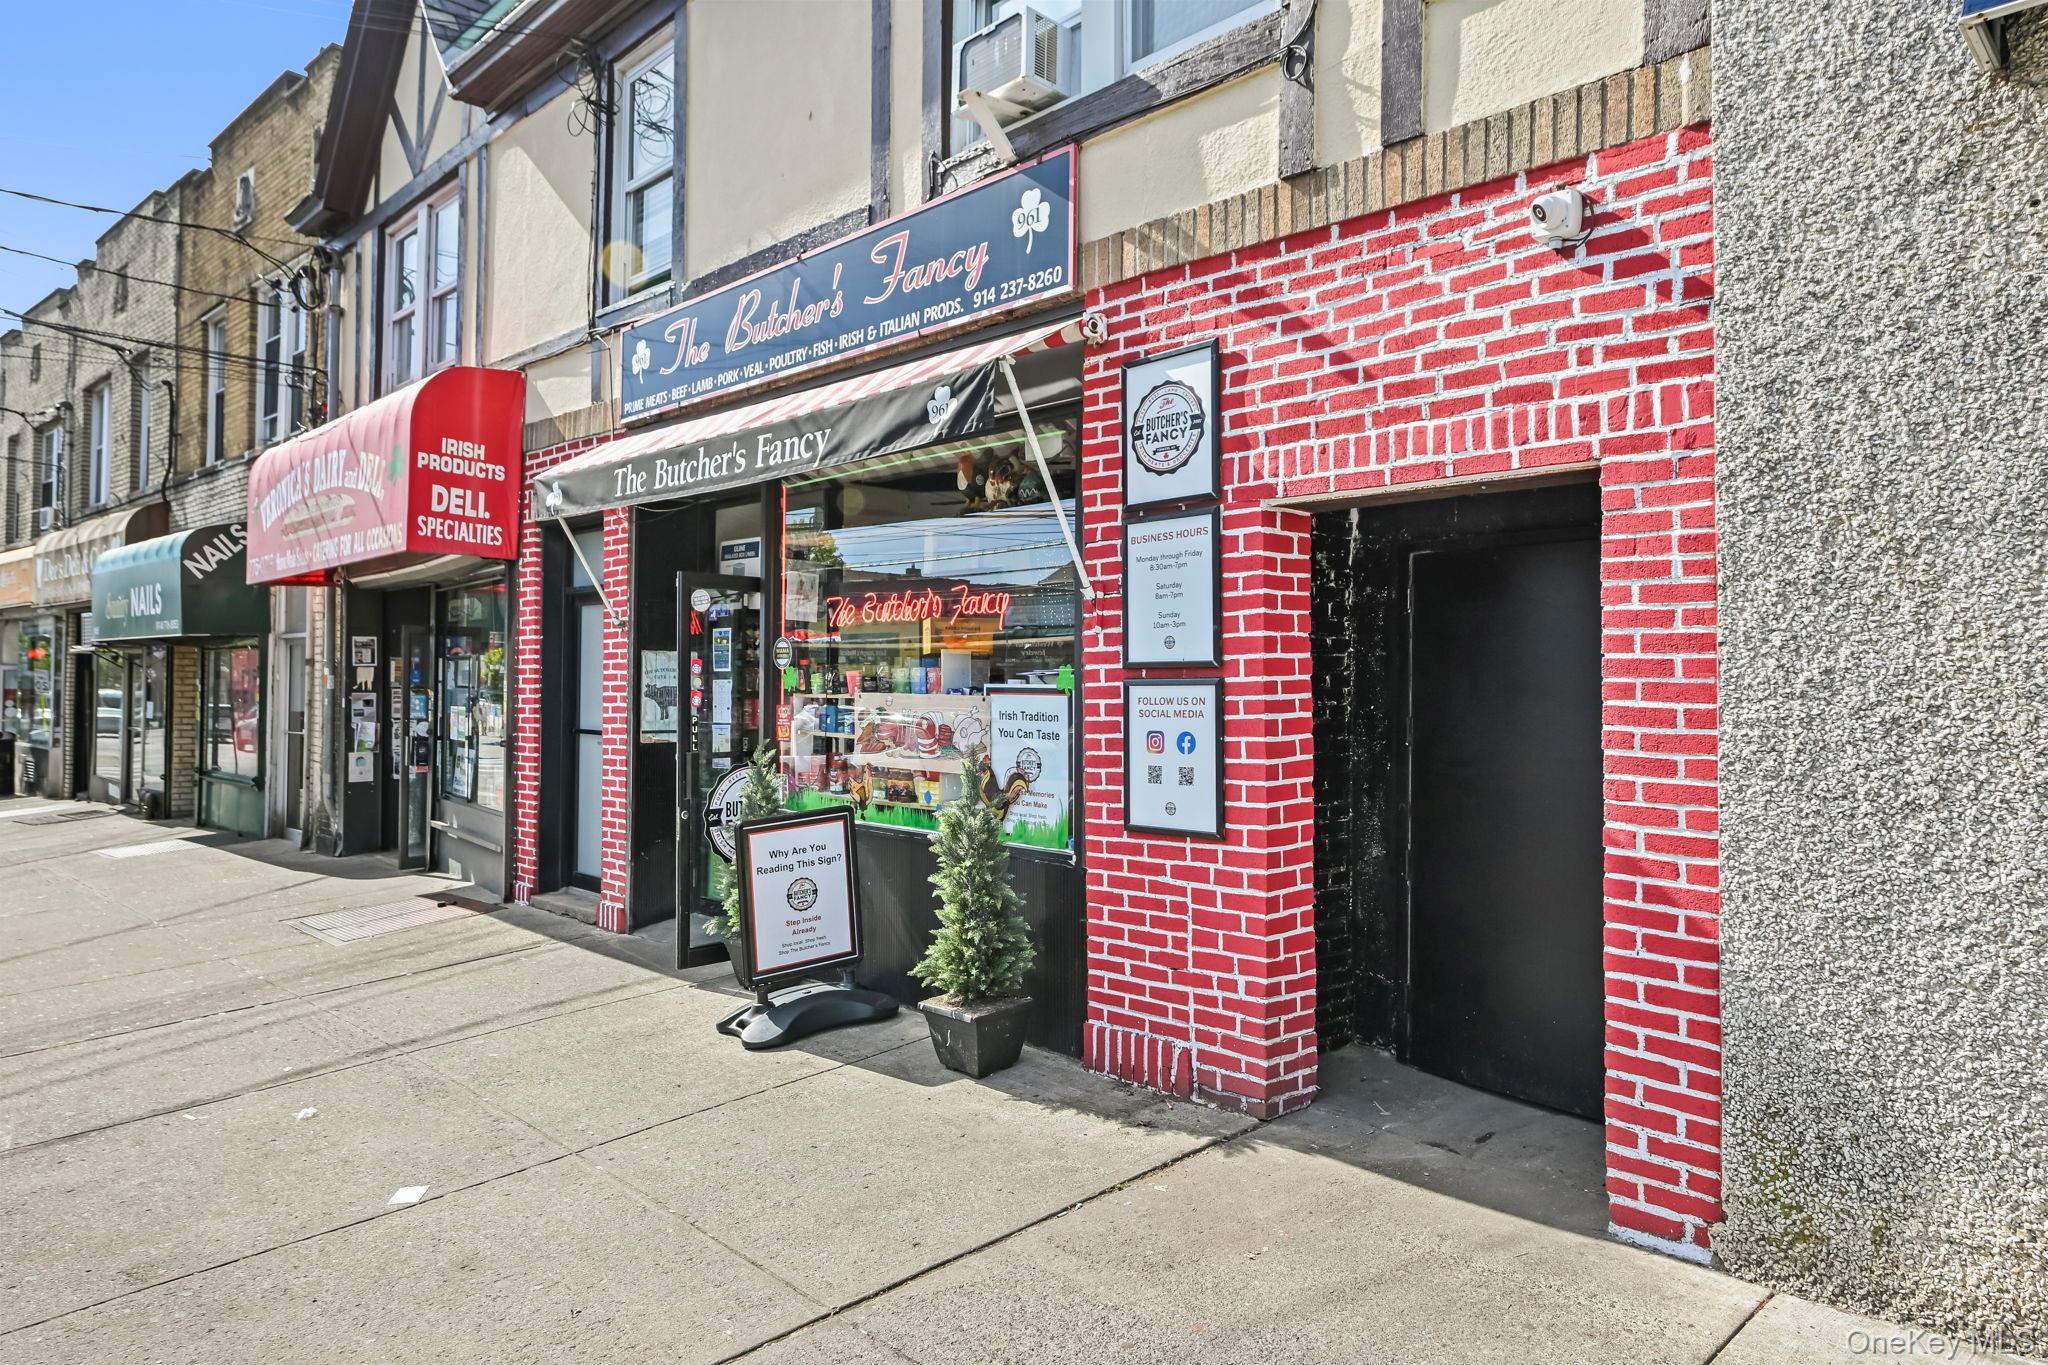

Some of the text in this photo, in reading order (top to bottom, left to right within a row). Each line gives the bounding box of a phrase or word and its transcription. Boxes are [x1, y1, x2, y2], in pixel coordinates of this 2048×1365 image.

[1017, 207, 1041, 230] 961
[659, 230, 990, 376] The Butcher's Fancy
[624, 264, 1063, 415] PRIME MEATS BEEF LAMB PORK VEAL POULTRY FISH IRISH & ITALIAN PRODS. 914 237-8260
[1159, 397, 1175, 409] The
[1146, 410, 1188, 432] BUTCHER'S
[1145, 426, 1188, 446] FANCY
[441, 437, 486, 461] IRISH
[417, 451, 506, 481] PRODUCTS
[613, 428, 832, 497] The Butcher's Fancy
[260, 461, 311, 533] VERONICA'S
[313, 449, 346, 494] DAIRY
[417, 515, 503, 546] SPECIALTIES
[1130, 526, 1209, 545] BUSINESS HOURS
[339, 533, 352, 557] FOR
[352, 530, 365, 552] ALL
[366, 522, 403, 552] OCCASIONS
[182, 523, 248, 580] NAILS
[1136, 549, 1203, 564] Monday through Friday
[1149, 561, 1188, 572] 8:30am-7pm
[1155, 581, 1183, 591] Saturday
[130, 582, 162, 617] NAILS
[1155, 592, 1184, 600] 8am-7pm
[826, 584, 1010, 631] The Butcher's Fancy
[1158, 611, 1181, 620] Sunday
[1153, 621, 1187, 629] 10am-3pm
[1137, 697, 1206, 706] FOLLOW US ON
[999, 711, 1060, 722] Irish Tradition
[1138, 709, 1205, 719] SOCIAL MEDIA
[998, 728, 1060, 741] You Can Taste
[715, 772, 743, 806] PORK BEEF
[1028, 790, 1055, 799] Memories
[1022, 799, 1033, 807] Can
[1033, 801, 1048, 809] Make
[769, 843, 827, 859] Why Are You
[756, 853, 842, 875] Reading This Sign?
[793, 893, 812, 901] FANCY
[785, 914, 822, 927] Step Inside
[791, 925, 817, 936] Already
[799, 943, 818, 952] Butcher's
